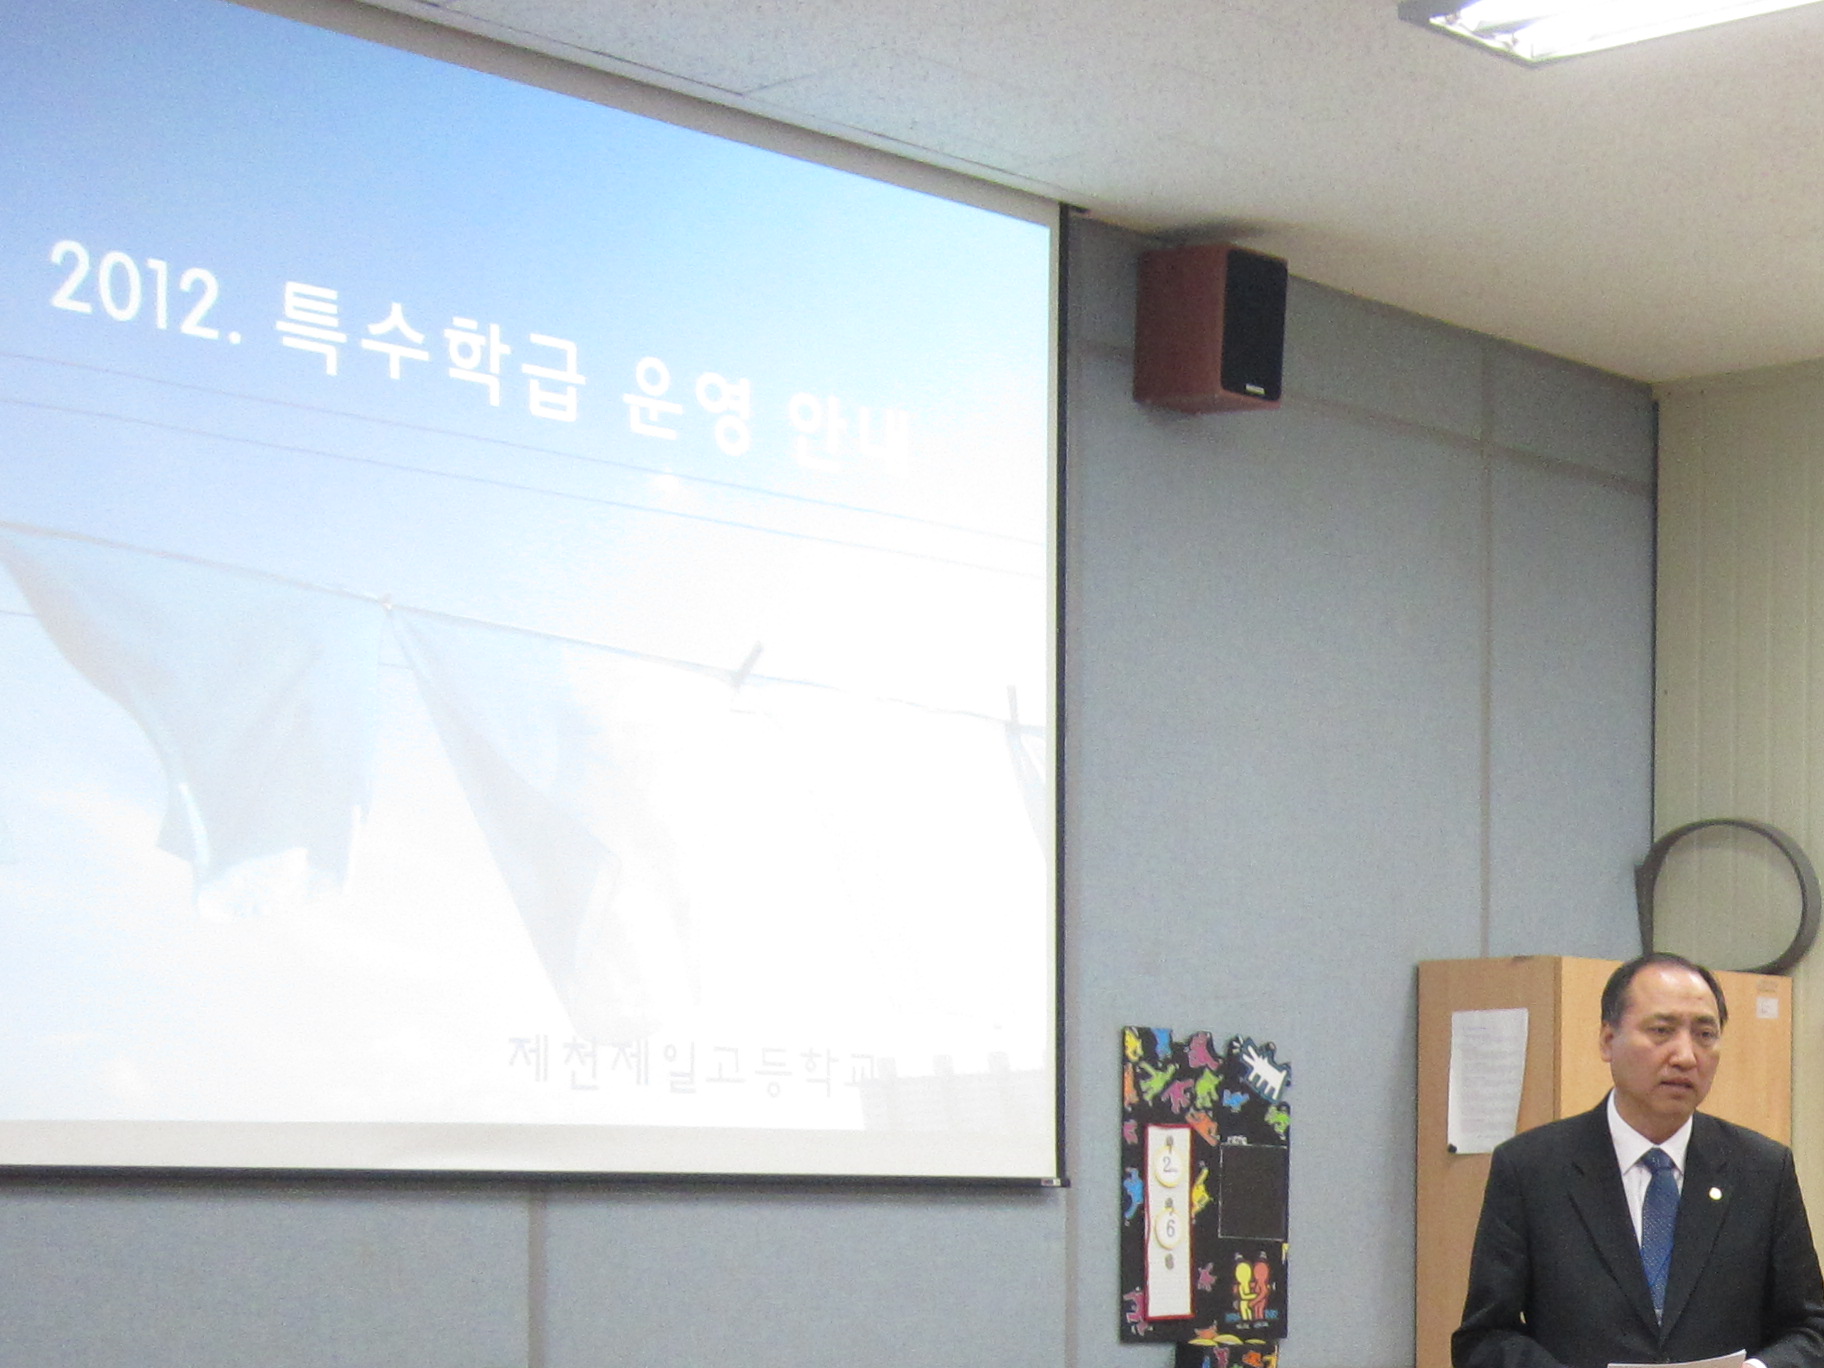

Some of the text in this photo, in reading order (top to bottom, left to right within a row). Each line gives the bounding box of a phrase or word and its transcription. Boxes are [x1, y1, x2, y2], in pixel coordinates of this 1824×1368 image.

[49, 240, 910, 478] 2012. 특수학급 운영 안내
[508, 1034, 880, 1099] 제천제일고등학교
[1166, 1219, 1175, 1238] 6
